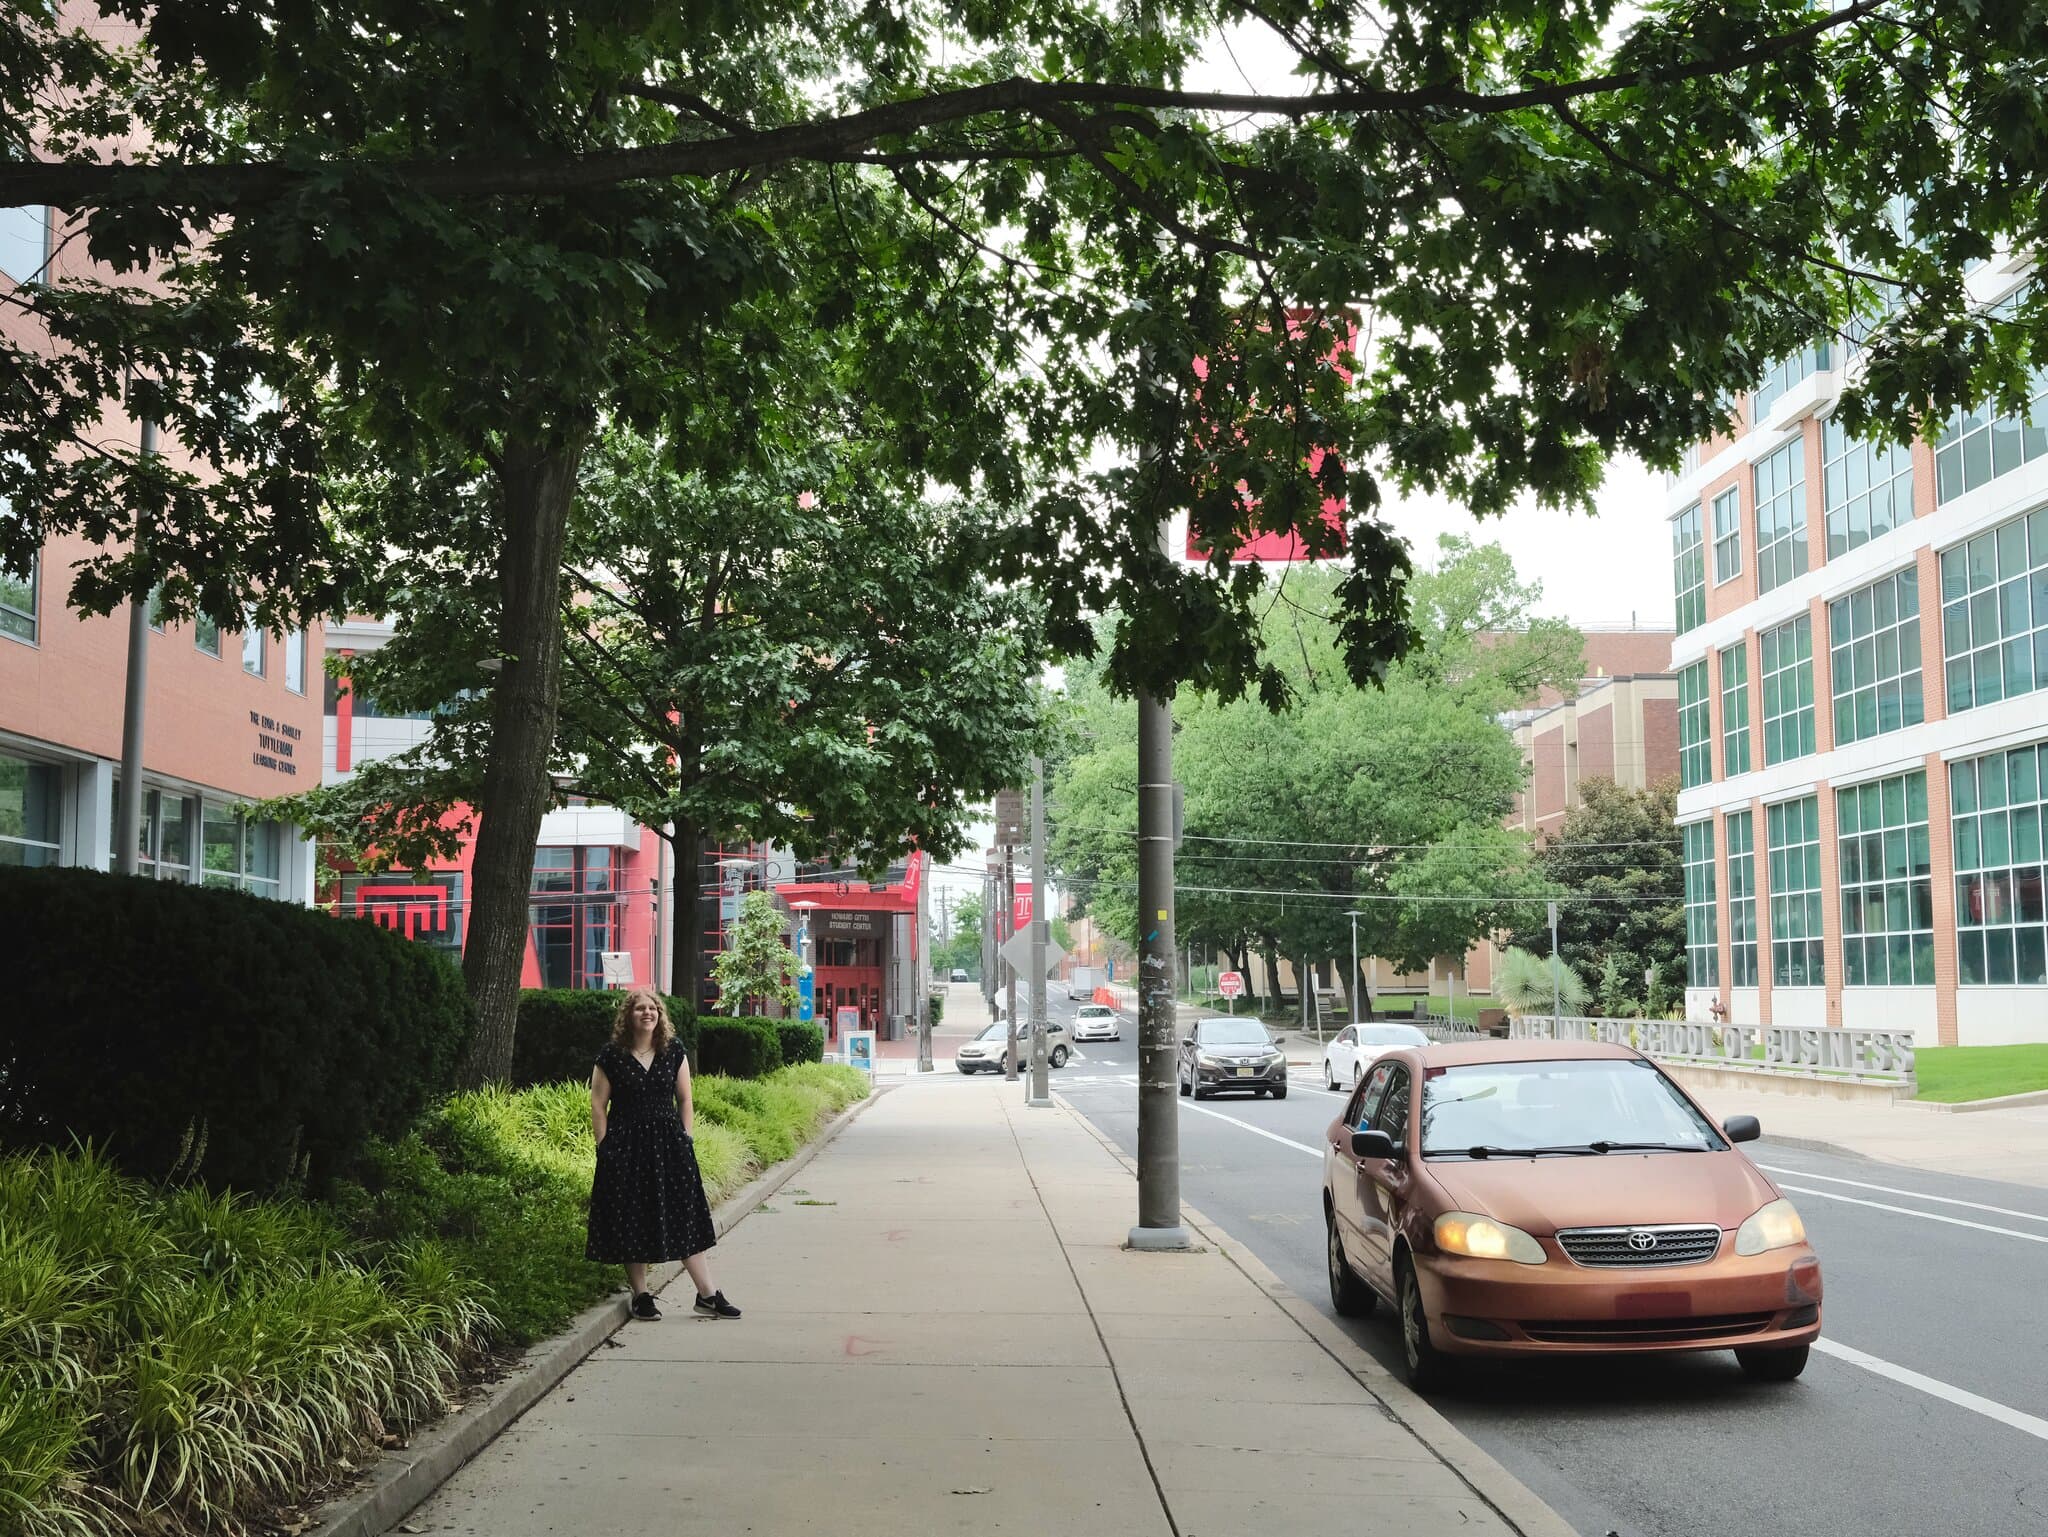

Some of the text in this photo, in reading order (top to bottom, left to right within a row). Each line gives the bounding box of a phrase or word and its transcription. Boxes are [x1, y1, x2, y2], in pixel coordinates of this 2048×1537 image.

[259, 733, 293, 758] TUTTLEMAN
[1636, 1022, 1717, 1058] SCHOOL
[1723, 1026, 1756, 1060] OF
[1765, 1028, 1915, 1073] BUSINESS
